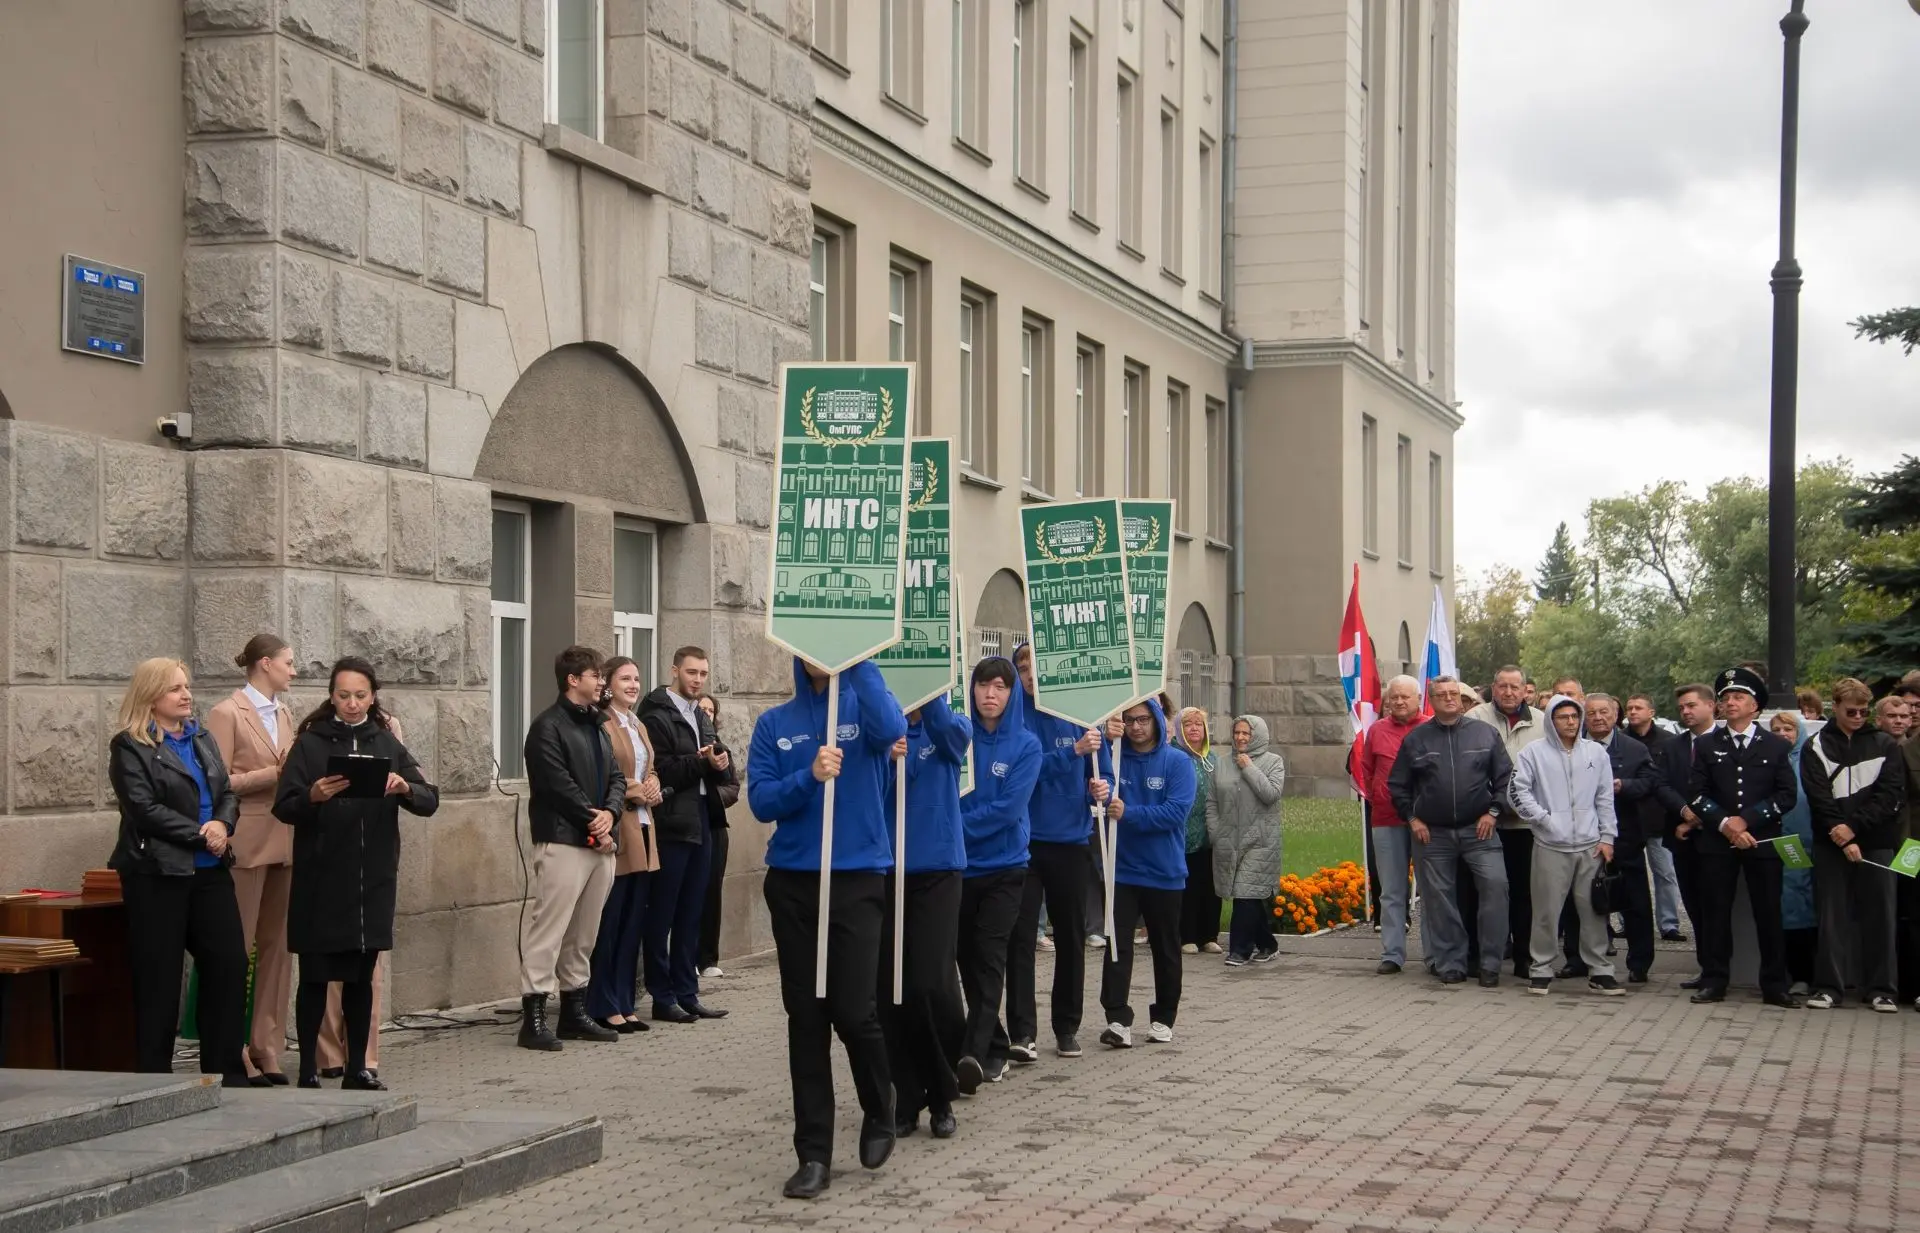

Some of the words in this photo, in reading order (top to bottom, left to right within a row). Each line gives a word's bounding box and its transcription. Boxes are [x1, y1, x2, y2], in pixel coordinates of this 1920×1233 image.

[829, 424, 863, 435] ОмГУПС
[803, 497, 880, 530] ИНТС
[1050, 600, 1107, 626] ТИЖТ
